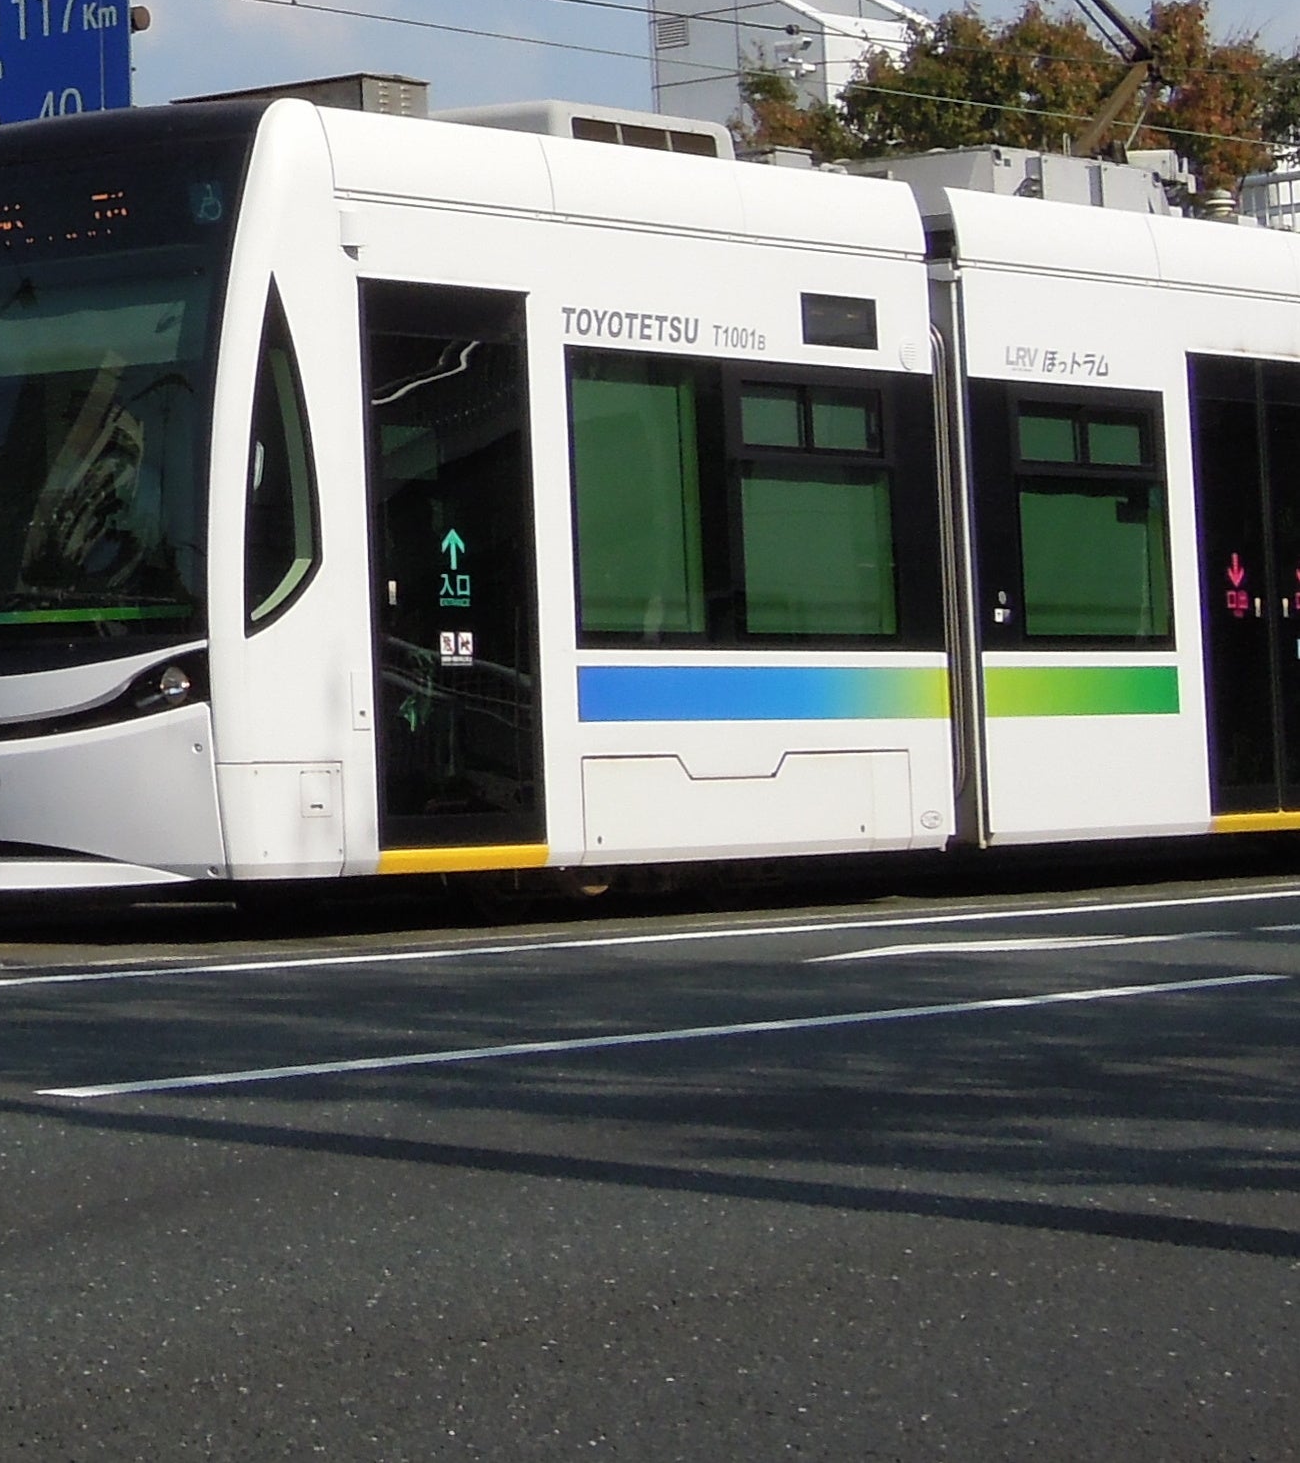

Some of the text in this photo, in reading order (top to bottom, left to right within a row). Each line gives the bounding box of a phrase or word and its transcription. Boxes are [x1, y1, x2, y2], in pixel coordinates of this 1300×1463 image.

[562, 307, 766, 351] TOYOTETSU T1001B
[1005, 345, 1109, 377] LRV ほっトラム
[439, 574, 471, 597] 入口
